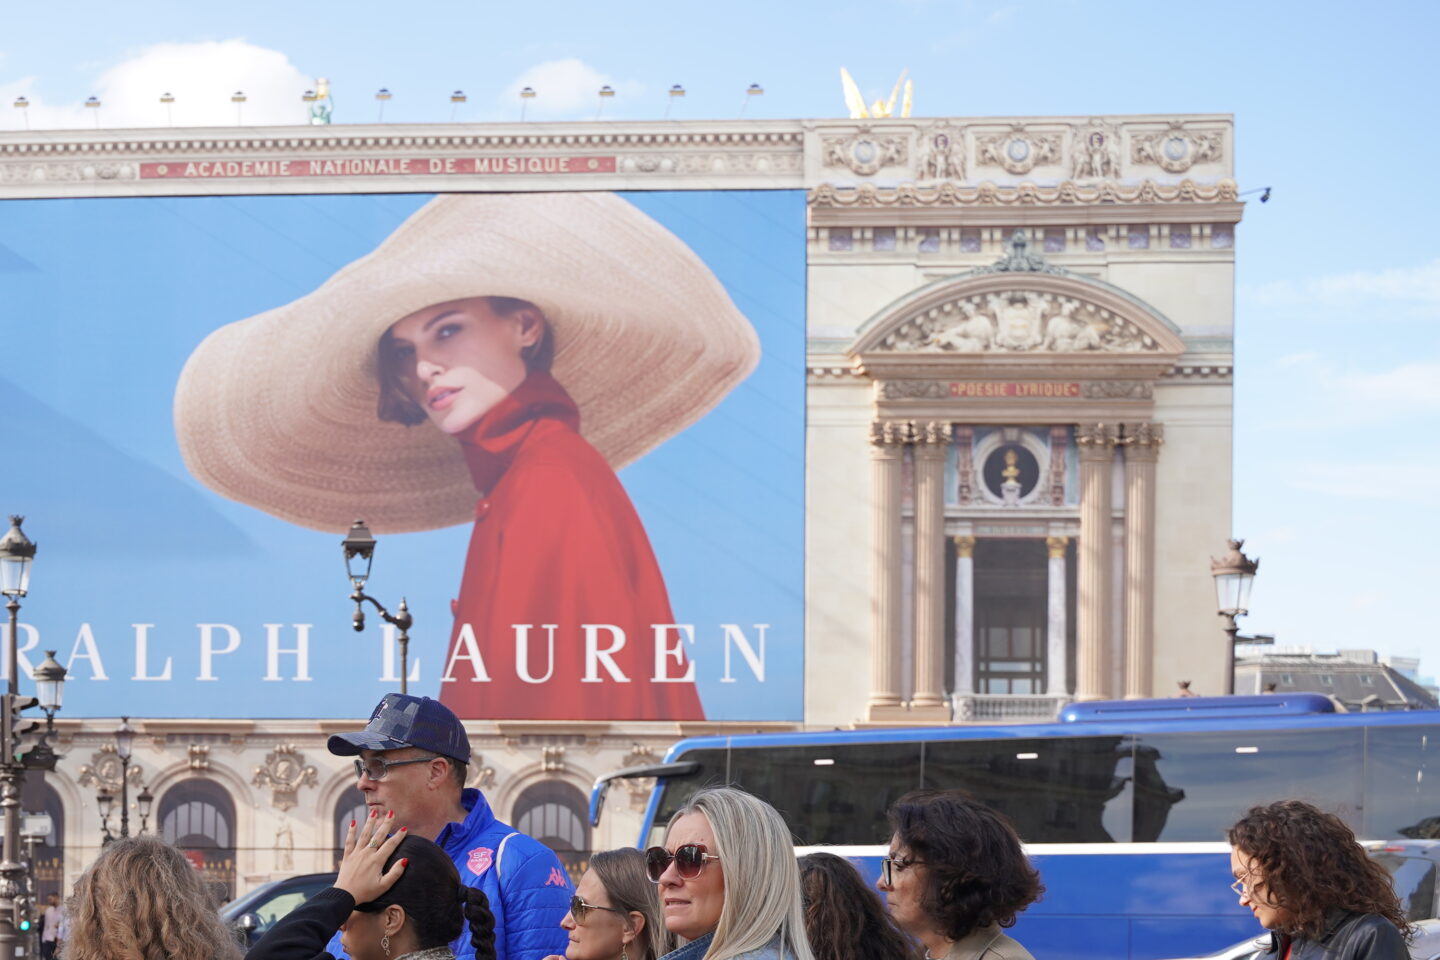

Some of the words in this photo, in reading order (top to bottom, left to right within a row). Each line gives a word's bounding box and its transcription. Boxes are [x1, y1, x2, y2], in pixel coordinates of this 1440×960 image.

[184, 160, 291, 177] ACADEMIE
[310, 158, 410, 176] NATIONALE
[428, 158, 457, 174] DE
[474, 157, 570, 173] MUSIQUE
[1015, 383, 1070, 397] LYRIQUE
[378, 623, 771, 684] LAUREN
